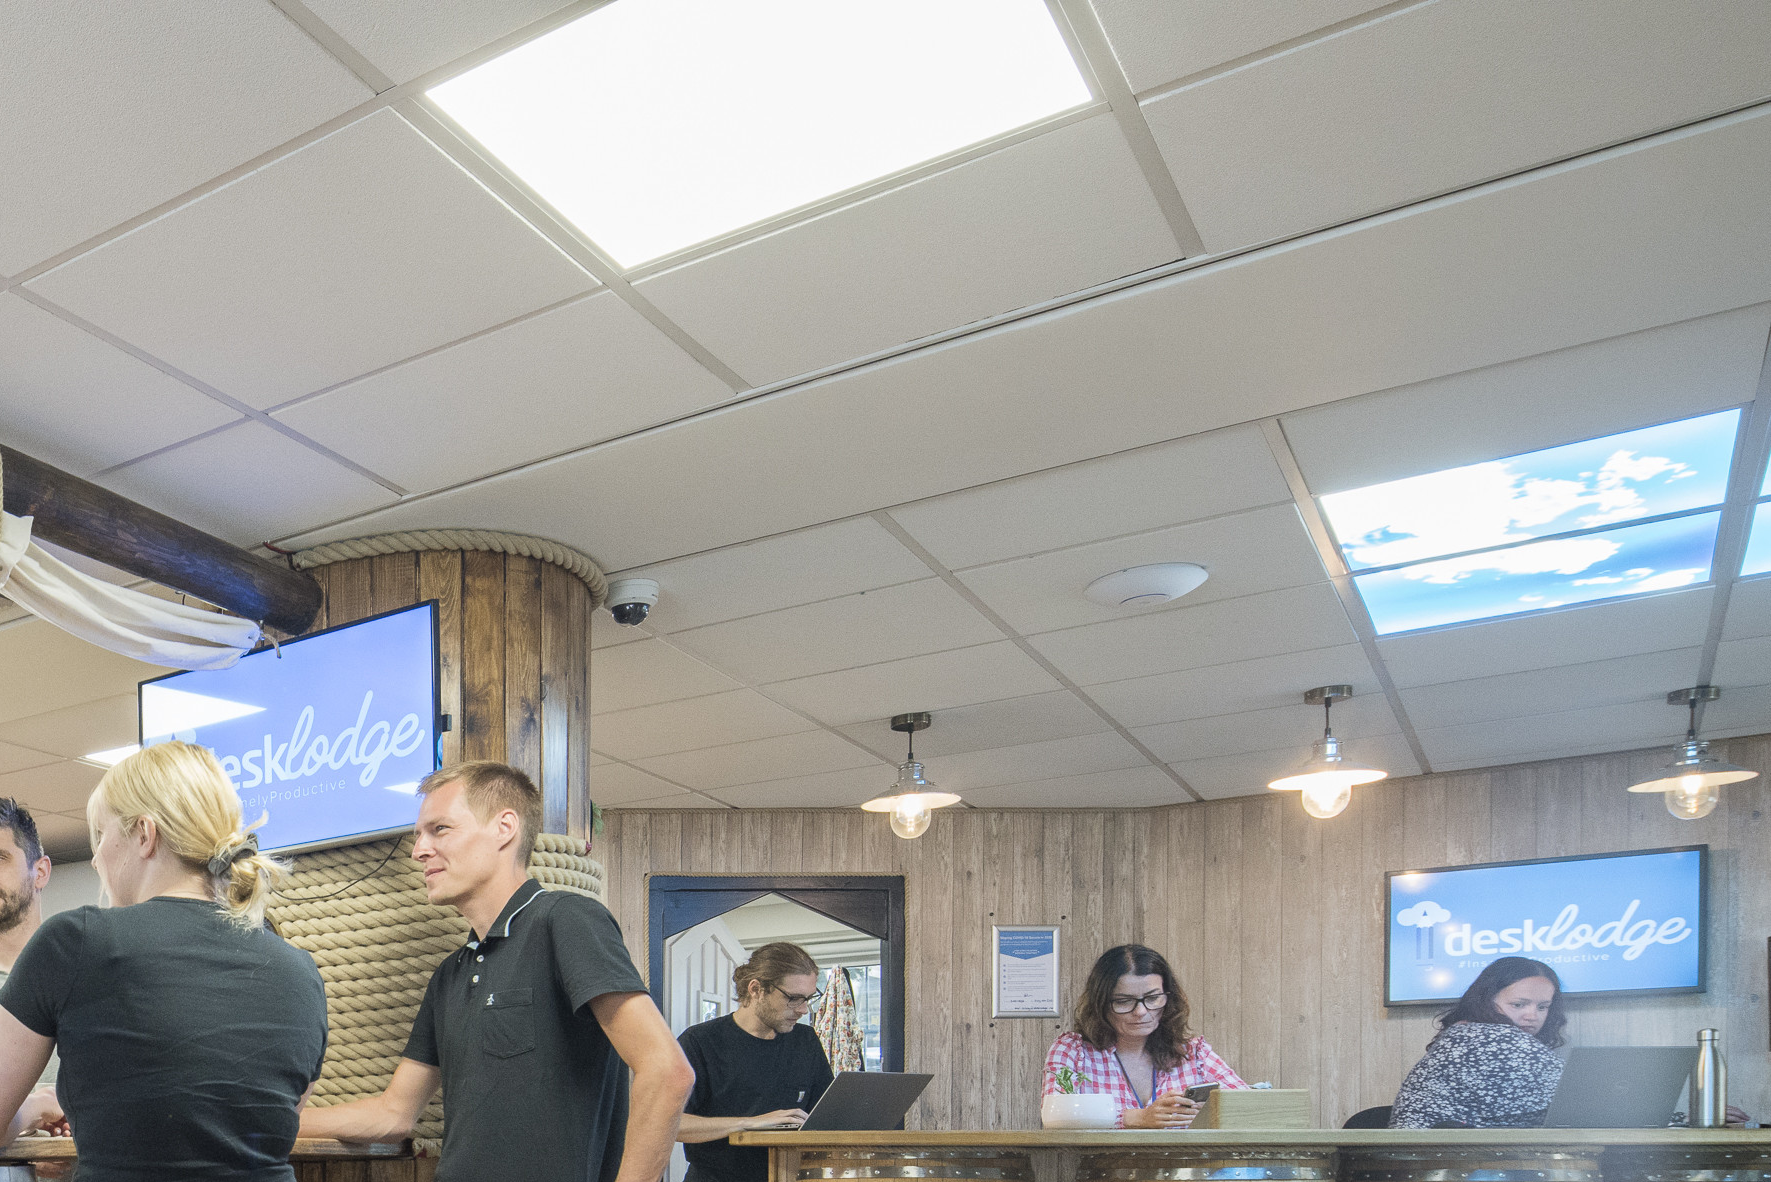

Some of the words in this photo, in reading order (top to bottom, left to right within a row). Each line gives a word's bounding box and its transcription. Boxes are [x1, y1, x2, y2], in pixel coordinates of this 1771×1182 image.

[223, 690, 426, 791] esklodge
[241, 780, 347, 808] nelyProductive
[1444, 899, 1693, 962] desklodge
